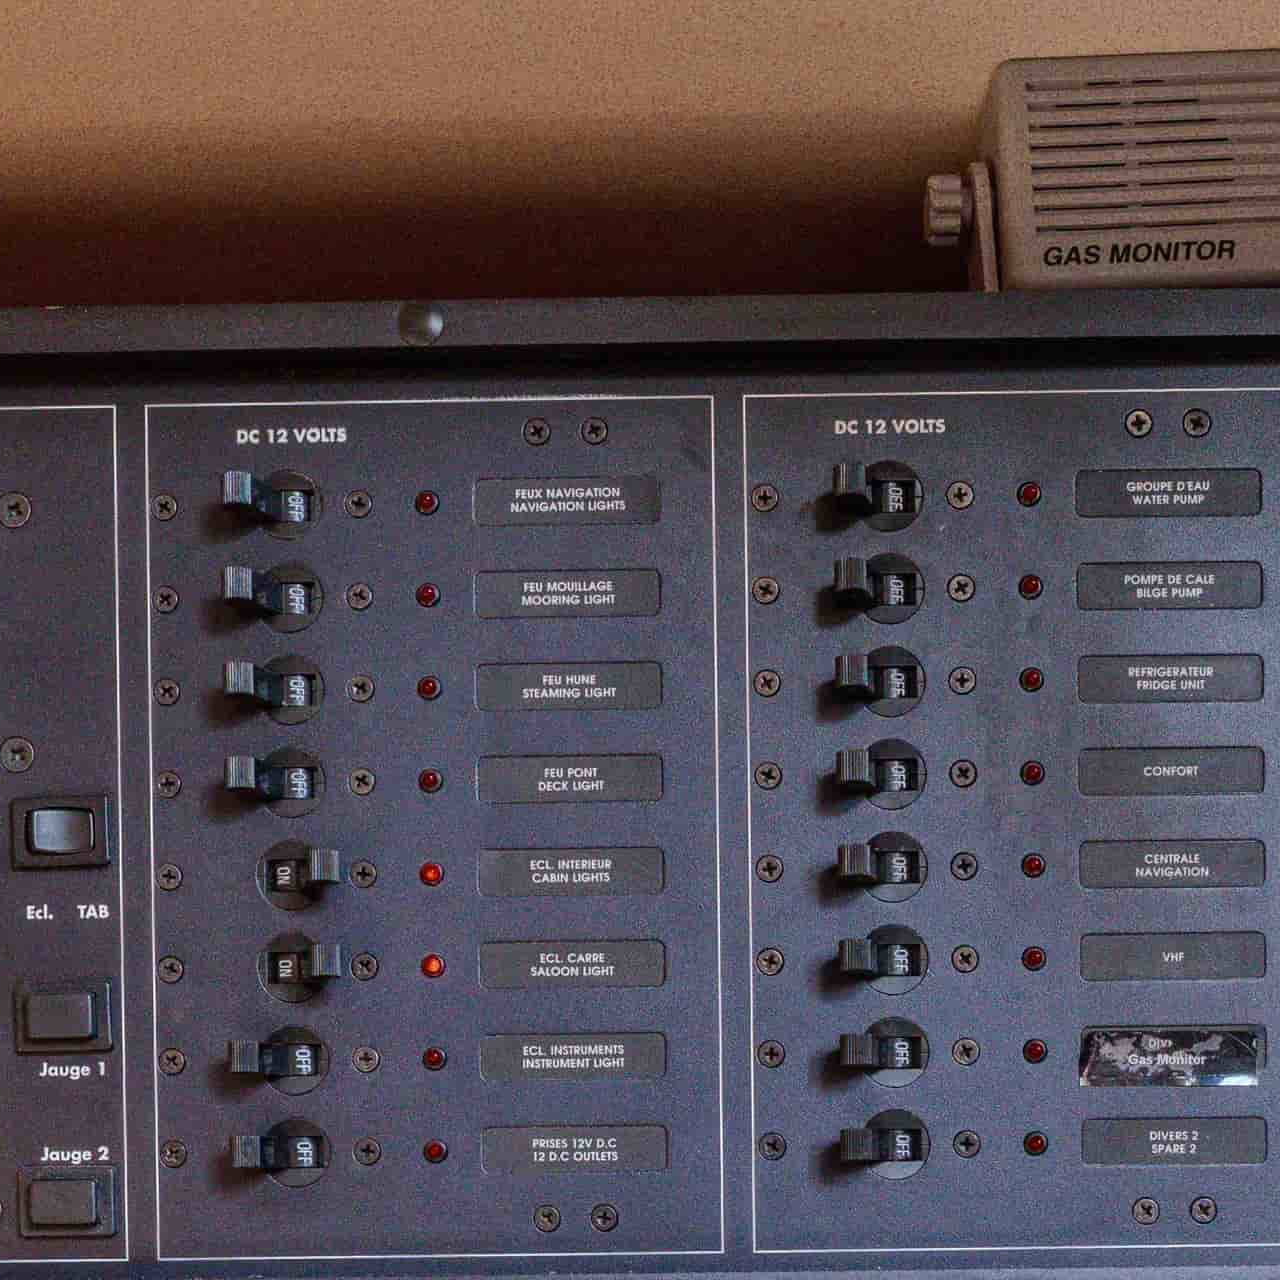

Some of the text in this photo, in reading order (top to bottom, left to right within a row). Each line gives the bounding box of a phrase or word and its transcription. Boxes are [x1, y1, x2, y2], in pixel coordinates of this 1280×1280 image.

[1044, 240, 1236, 266] GAS MONITOR
[834, 419, 946, 434] DC 12 VOLTS
[236, 428, 347, 444] DC 12 VOLTS
[1127, 481, 1210, 492] GROUPE D'EAU
[515, 487, 620, 498] FEUX NAVIGATION
[1133, 494, 1205, 505] WATER PUMP
[510, 501, 626, 512] NAVIGATION LIGHTS
[1124, 574, 1215, 585] POMPE DE CALE
[523, 581, 612, 592] FEU MOUILLAGE
[1136, 587, 1203, 598] BILGE PUMP
[521, 594, 616, 605] MOORING LIGHT
[1128, 667, 1213, 678] REFRIGERATEUR
[543, 675, 596, 685] FEU HUNE
[1136, 679, 1205, 690] FRIDGE UNIT
[523, 687, 616, 699] STEAMING LIGHT
[544, 768, 597, 778] FEU PONT
[1143, 766, 1198, 776] CONFORT
[538, 780, 604, 791] DECK LIGHT
[1144, 853, 1200, 864] CENTRALE
[530, 859, 612, 870] ECL. INTERIEUR
[277, 866, 291, 885] ON
[1135, 866, 1209, 877] NAVIGATION
[532, 872, 610, 883] CABIN LIGHTS
[27, 905, 109, 920] Ecl. TAB
[540, 953, 605, 964] ECL. CARRE
[1162, 952, 1184, 962] VHF
[279, 960, 293, 977] ON
[530, 966, 614, 977] SALOON LIGHT
[523, 1045, 624, 1056] ECL. INSTRUMENTS
[523, 1057, 624, 1069] INSTRUMENT LIGHT
[1128, 1054, 1207, 1065] Gas Monitor
[40, 1062, 91, 1080] Jauge
[1150, 1131, 1186, 1141] DIVERS
[532, 1138, 616, 1149] PRISES 12V D.C
[41, 1146, 109, 1164] Jauge 2
[1152, 1144, 1185, 1155] SPARE
[549, 1151, 618, 1162] D.C OUTLETS
